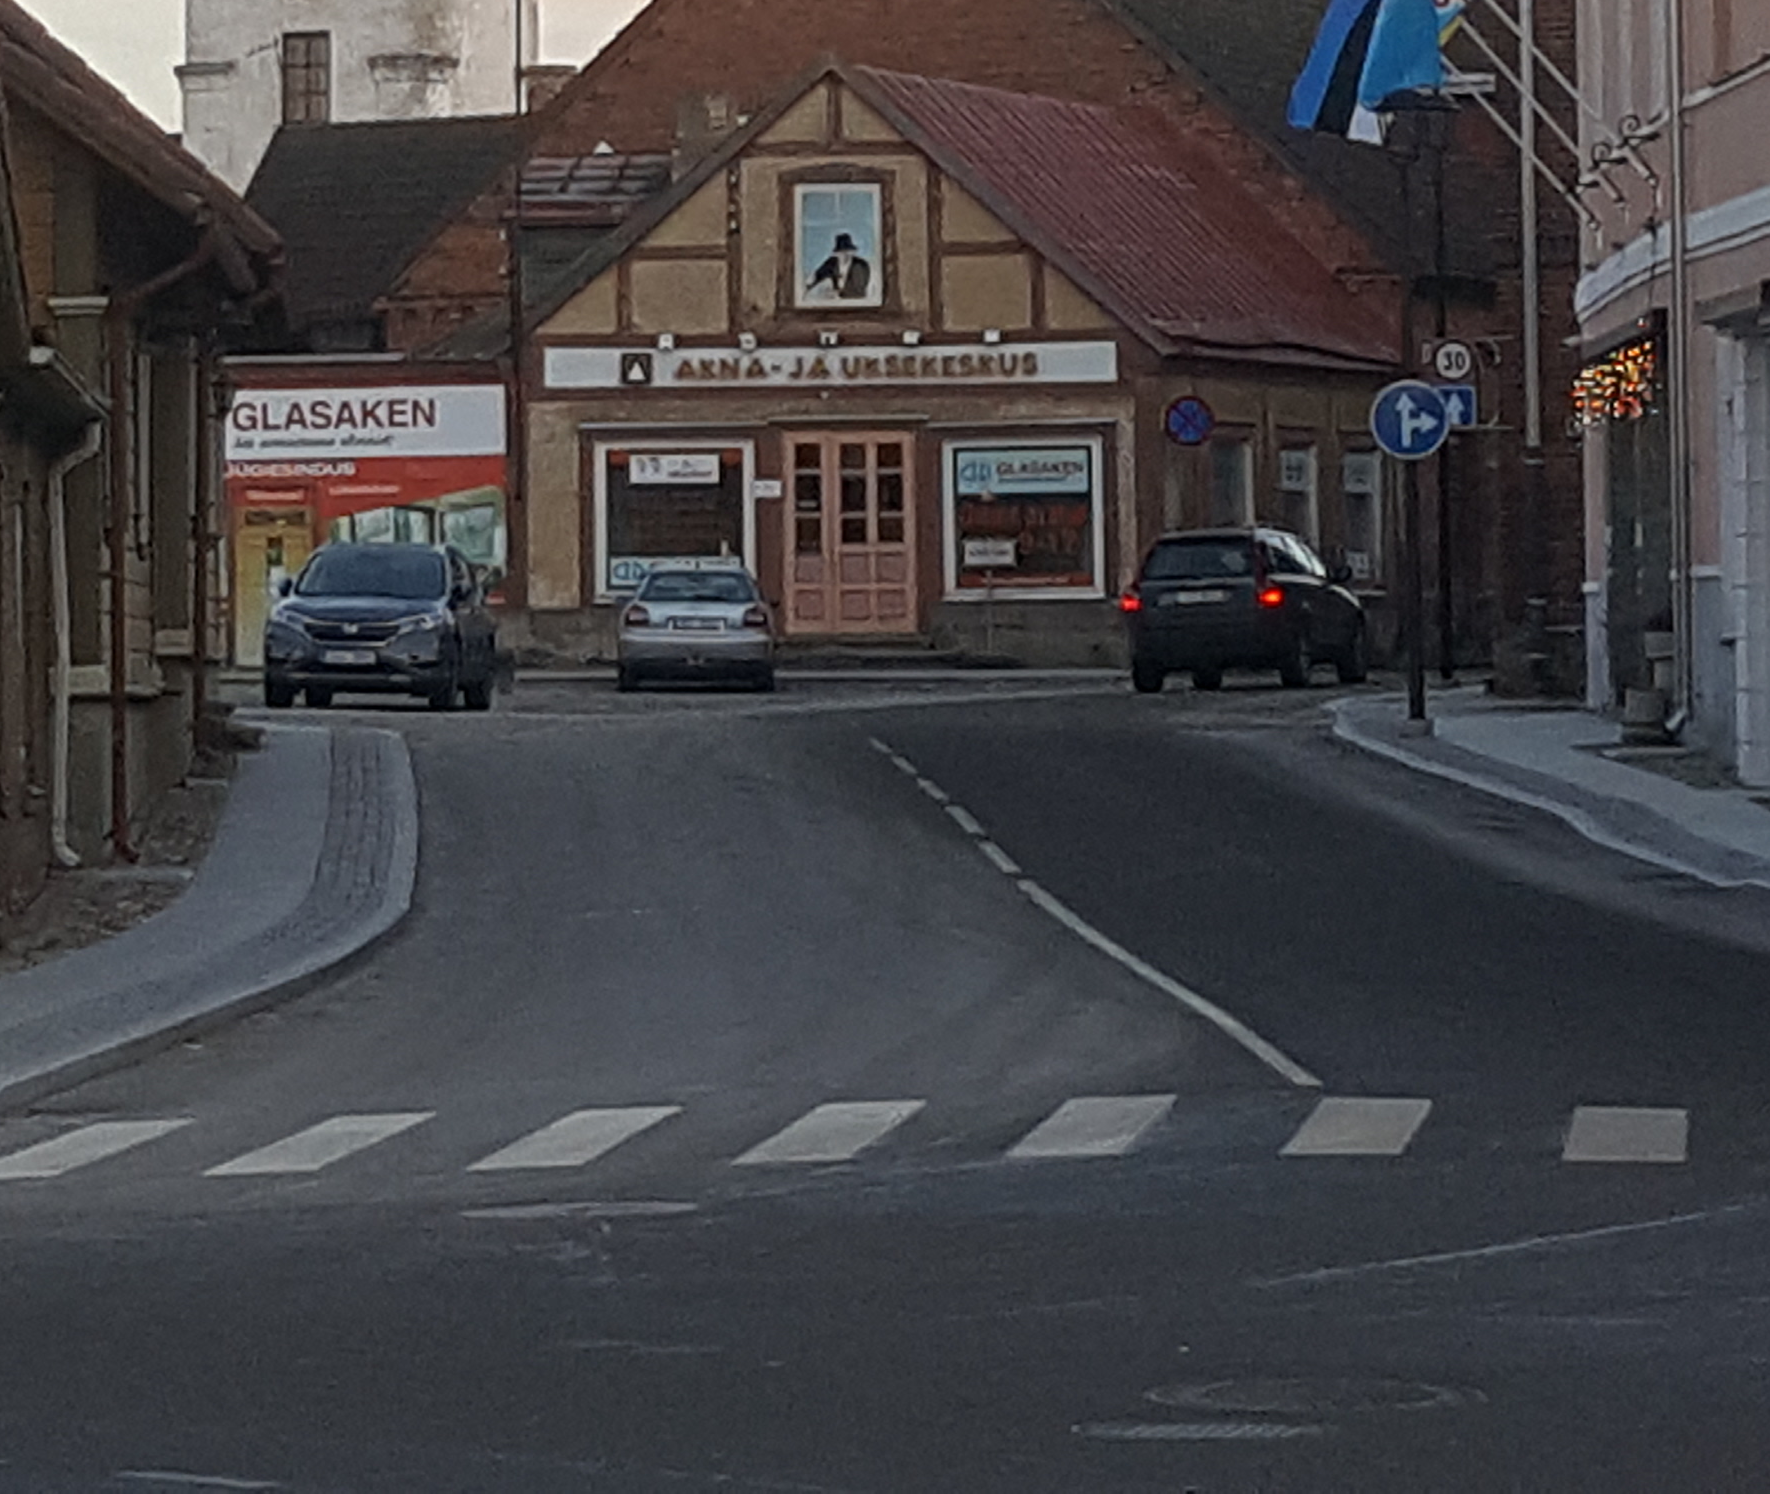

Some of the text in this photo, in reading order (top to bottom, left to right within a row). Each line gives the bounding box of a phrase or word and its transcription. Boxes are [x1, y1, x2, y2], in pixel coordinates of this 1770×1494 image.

[788, 355, 832, 380] JA
[1443, 350, 1467, 371] 30
[232, 398, 436, 432] GLASAKEN
